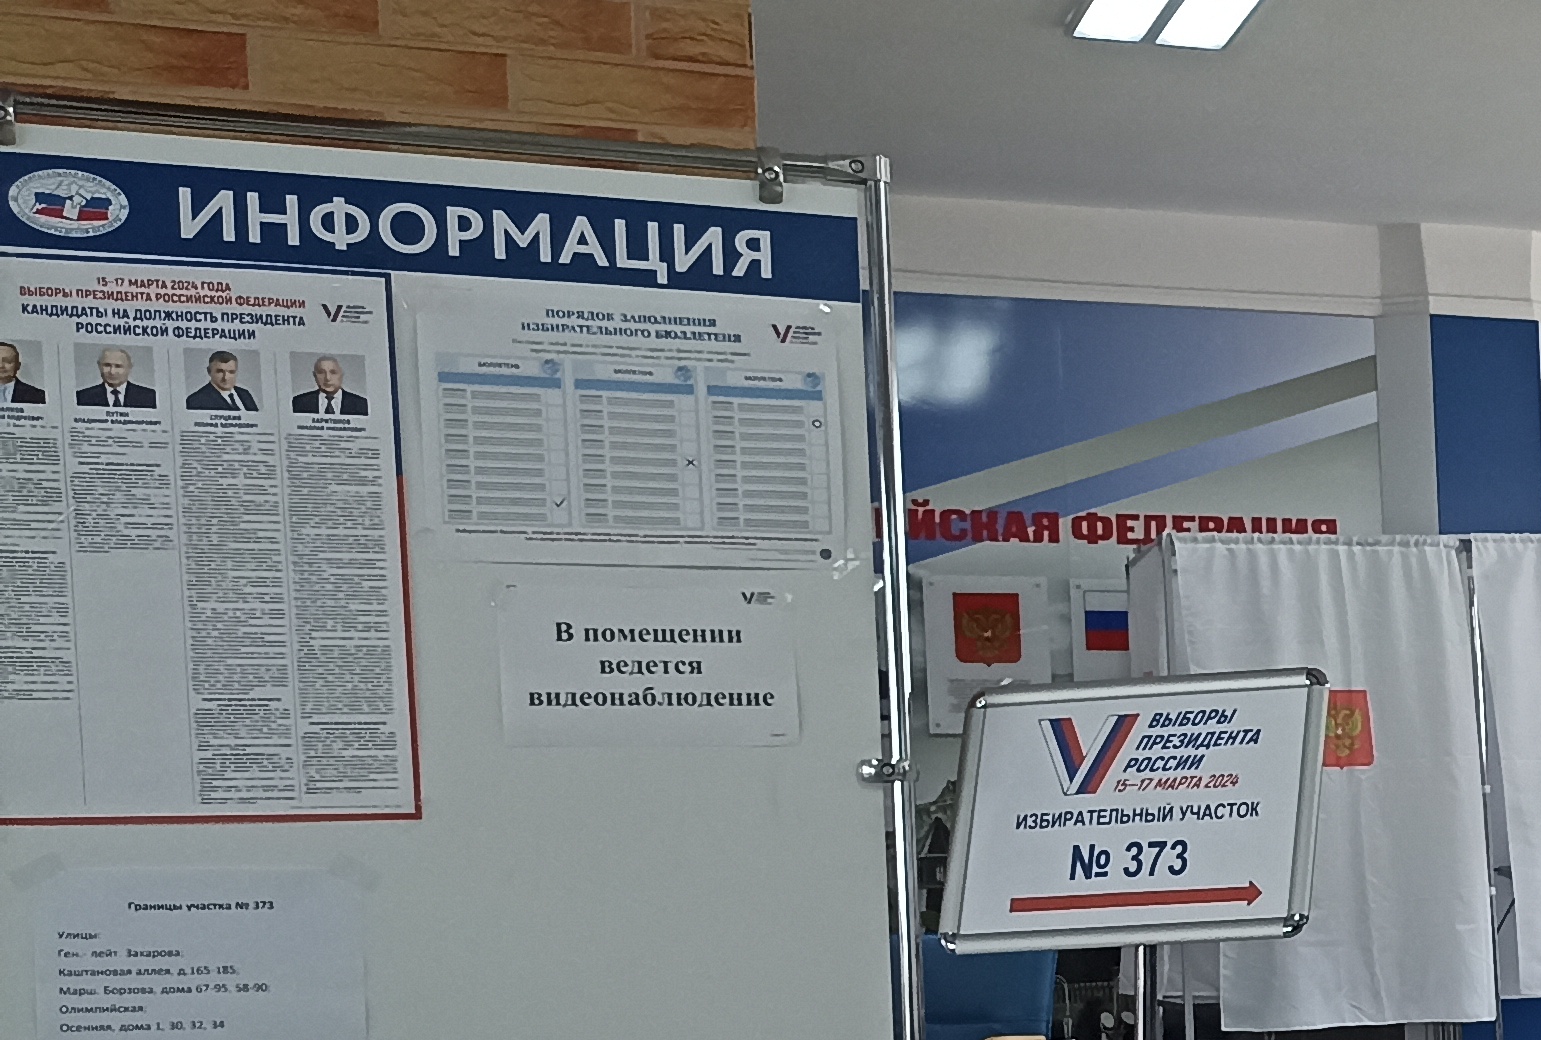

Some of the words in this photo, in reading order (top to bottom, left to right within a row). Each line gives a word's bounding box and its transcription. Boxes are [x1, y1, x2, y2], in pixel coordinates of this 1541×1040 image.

[178, 186, 773, 284] ИНФОРМАЦИЯ
[128, 278, 168, 290] МАРТА
[170, 280, 198, 291] 2024
[200, 281, 232, 293] ГОДА
[19, 286, 73, 298] ВЫБОРЫ
[75, 289, 153, 302] ПРЕЗИДЕНТА
[154, 292, 233, 306] РОССИЙСКОЙ
[234, 295, 306, 309] ФЕДЕРАЦИИ
[21, 303, 108, 319] КАНДИДАТЫ
[112, 308, 130, 320] НА
[132, 308, 218, 324] ДОЛЖНОСТЬ
[221, 312, 306, 327] ПРЕЗИДЕНТА
[545, 308, 615, 322] ПОРЯДОК
[75, 321, 169, 338] РОССИЙСКОЙ
[172, 325, 257, 341] ФЕДЕРАЦИИ
[520, 322, 652, 339] ИЗБИРАТЕЛЬНОГО
[907, 499, 1060, 544] ЙСКАЯ
[555, 621, 575, 643] В
[583, 627, 743, 644] помещении
[600, 658, 703, 676] ведется
[528, 687, 775, 708] видеонаблюдение
[1147, 708, 1238, 729] ВЫБОРЫ
[1135, 729, 1262, 752] ПРЕЗИДЕНТА
[1122, 754, 1206, 774] РОССИИ
[1154, 776, 1204, 791] МАРТА
[1204, 774, 1240, 789] 2024
[1015, 803, 1174, 830] ИЗБИРАТЕЛЬНЫЙ
[1178, 801, 1261, 821] УЧАСТОК
[1069, 842, 1111, 881] №
[1122, 839, 1189, 878] 373
[127, 901, 183, 912] Границы
[186, 903, 232, 912] участка
[252, 901, 275, 911] 373
[58, 968, 133, 977] Каштановая
[160, 986, 192, 995] дома
[119, 1023, 152, 1032] дома
